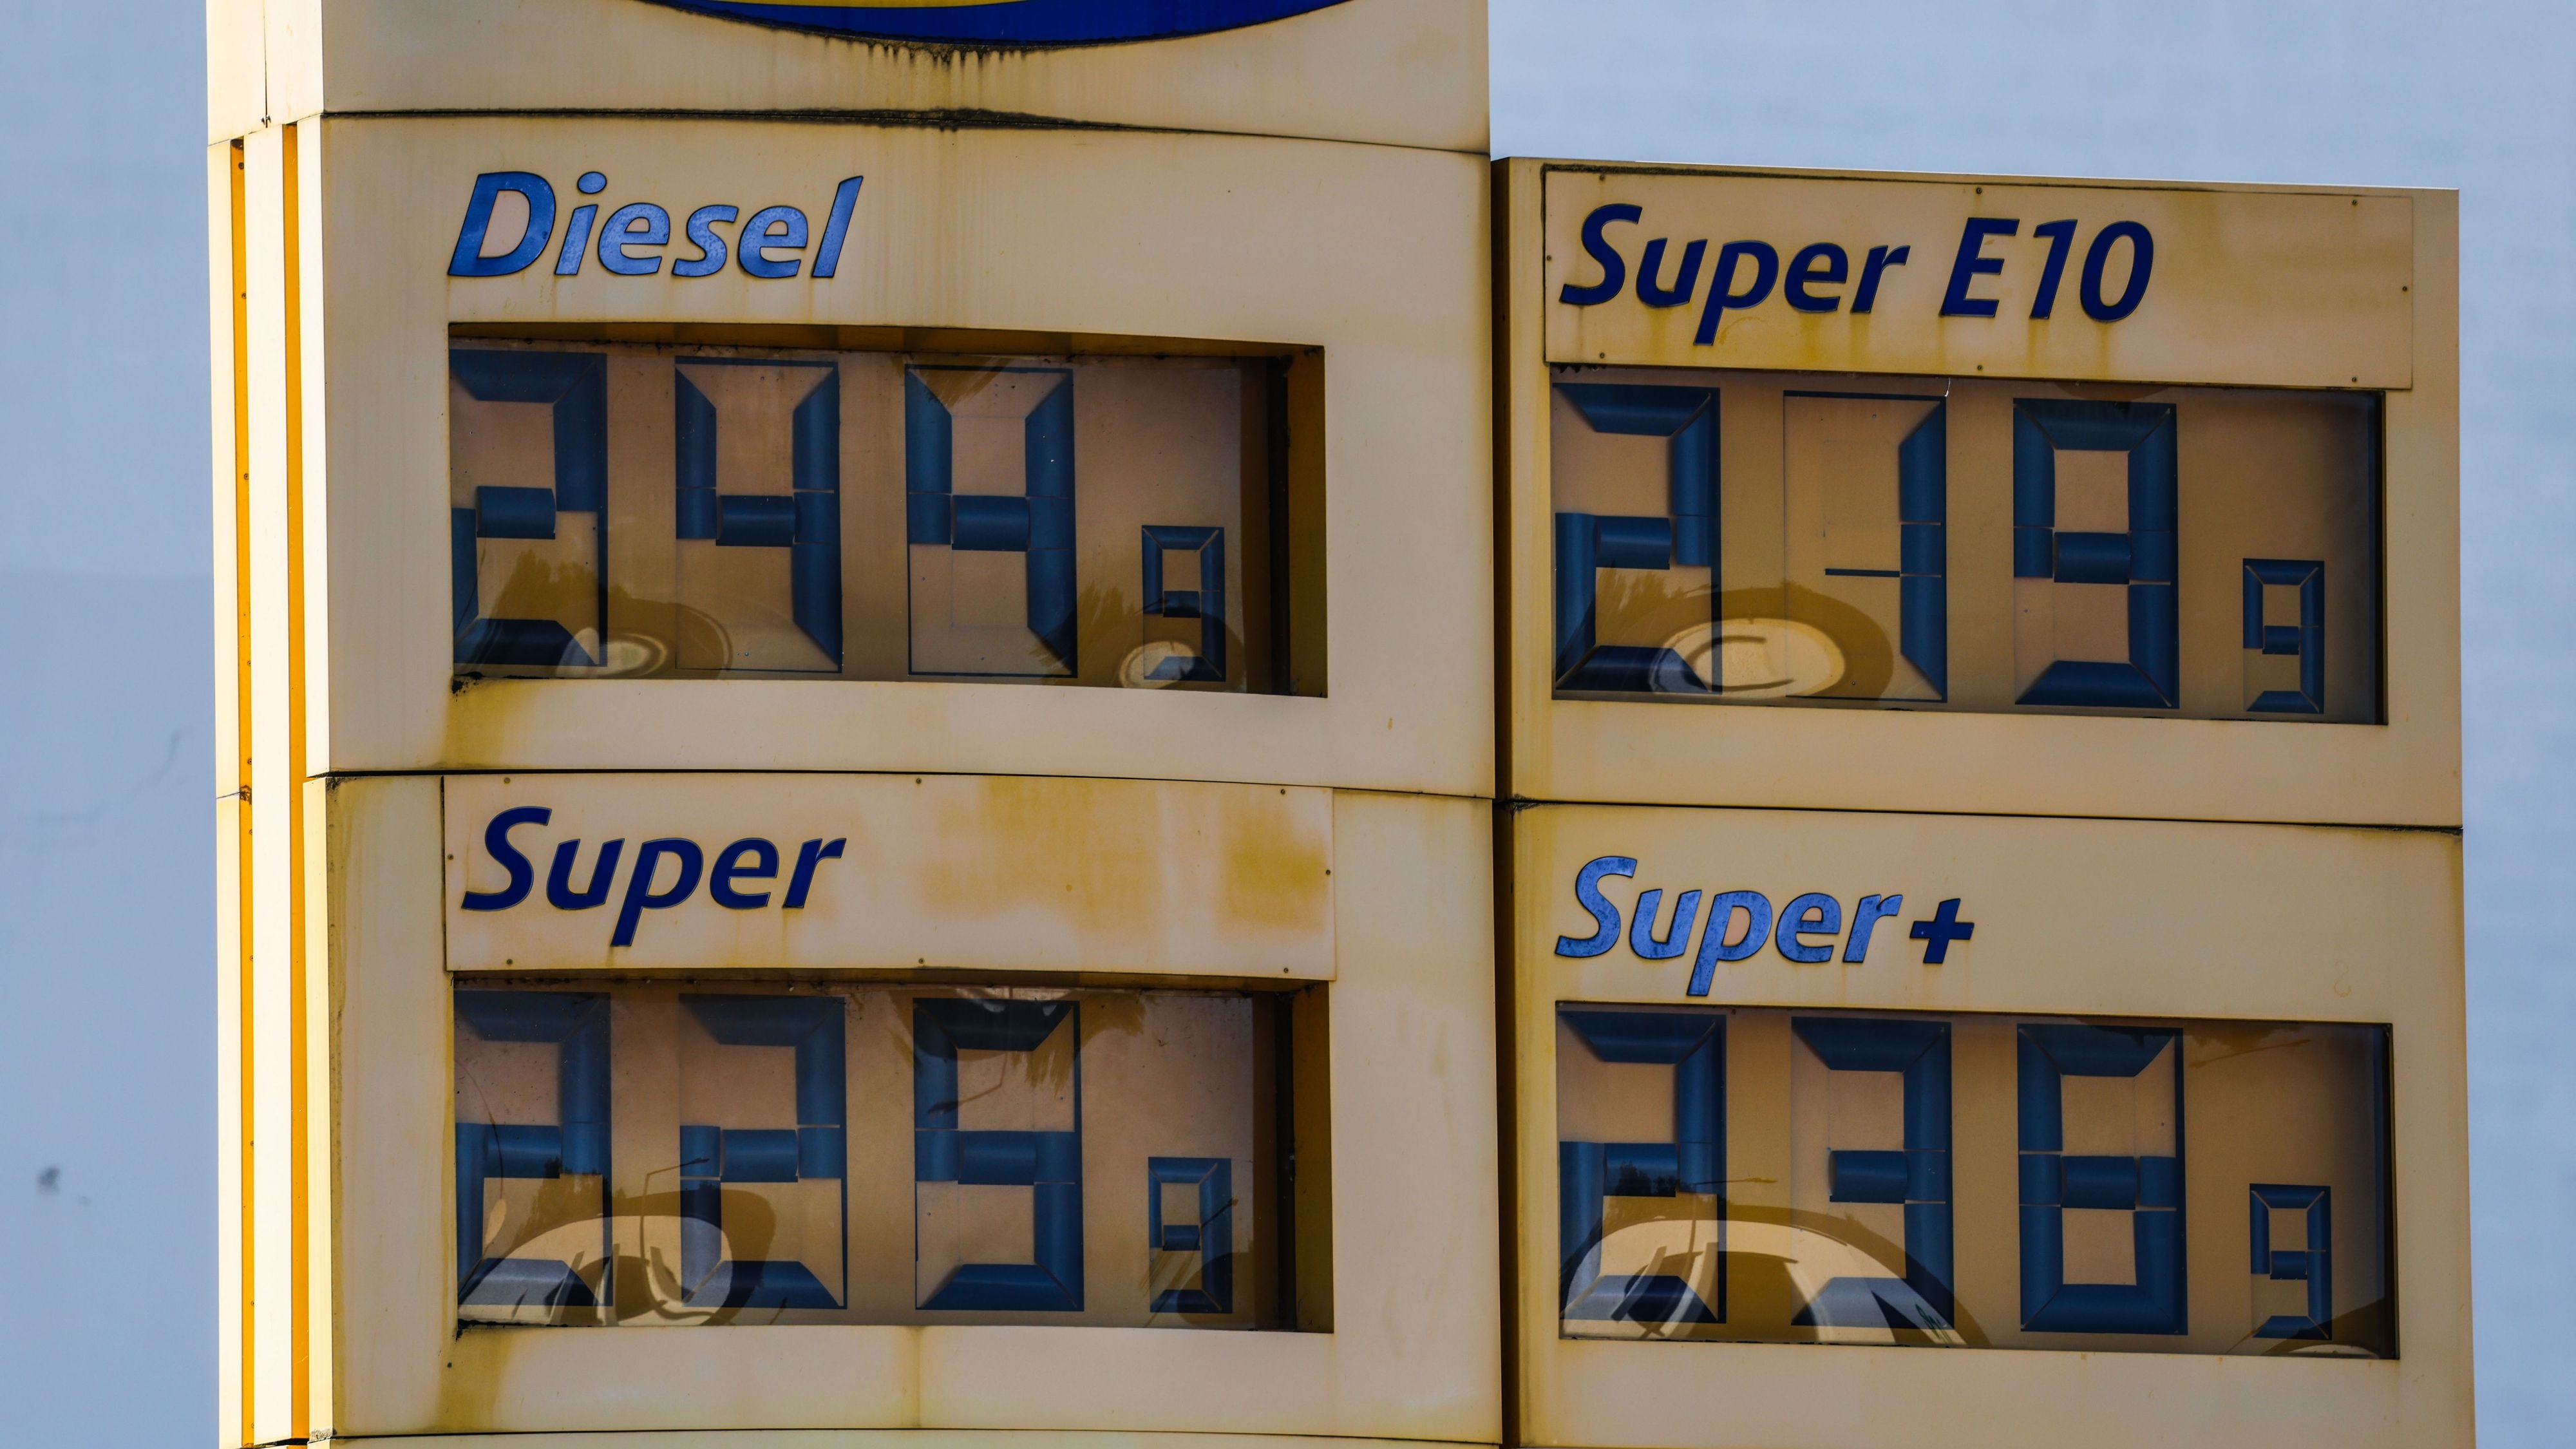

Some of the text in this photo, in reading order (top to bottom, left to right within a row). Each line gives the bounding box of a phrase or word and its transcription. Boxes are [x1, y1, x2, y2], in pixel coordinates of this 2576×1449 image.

[448, 172, 863, 278] Diesel
[1561, 204, 2154, 345] Super E10
[462, 806, 846, 946] Super
[1555, 856, 1975, 996] Super+
